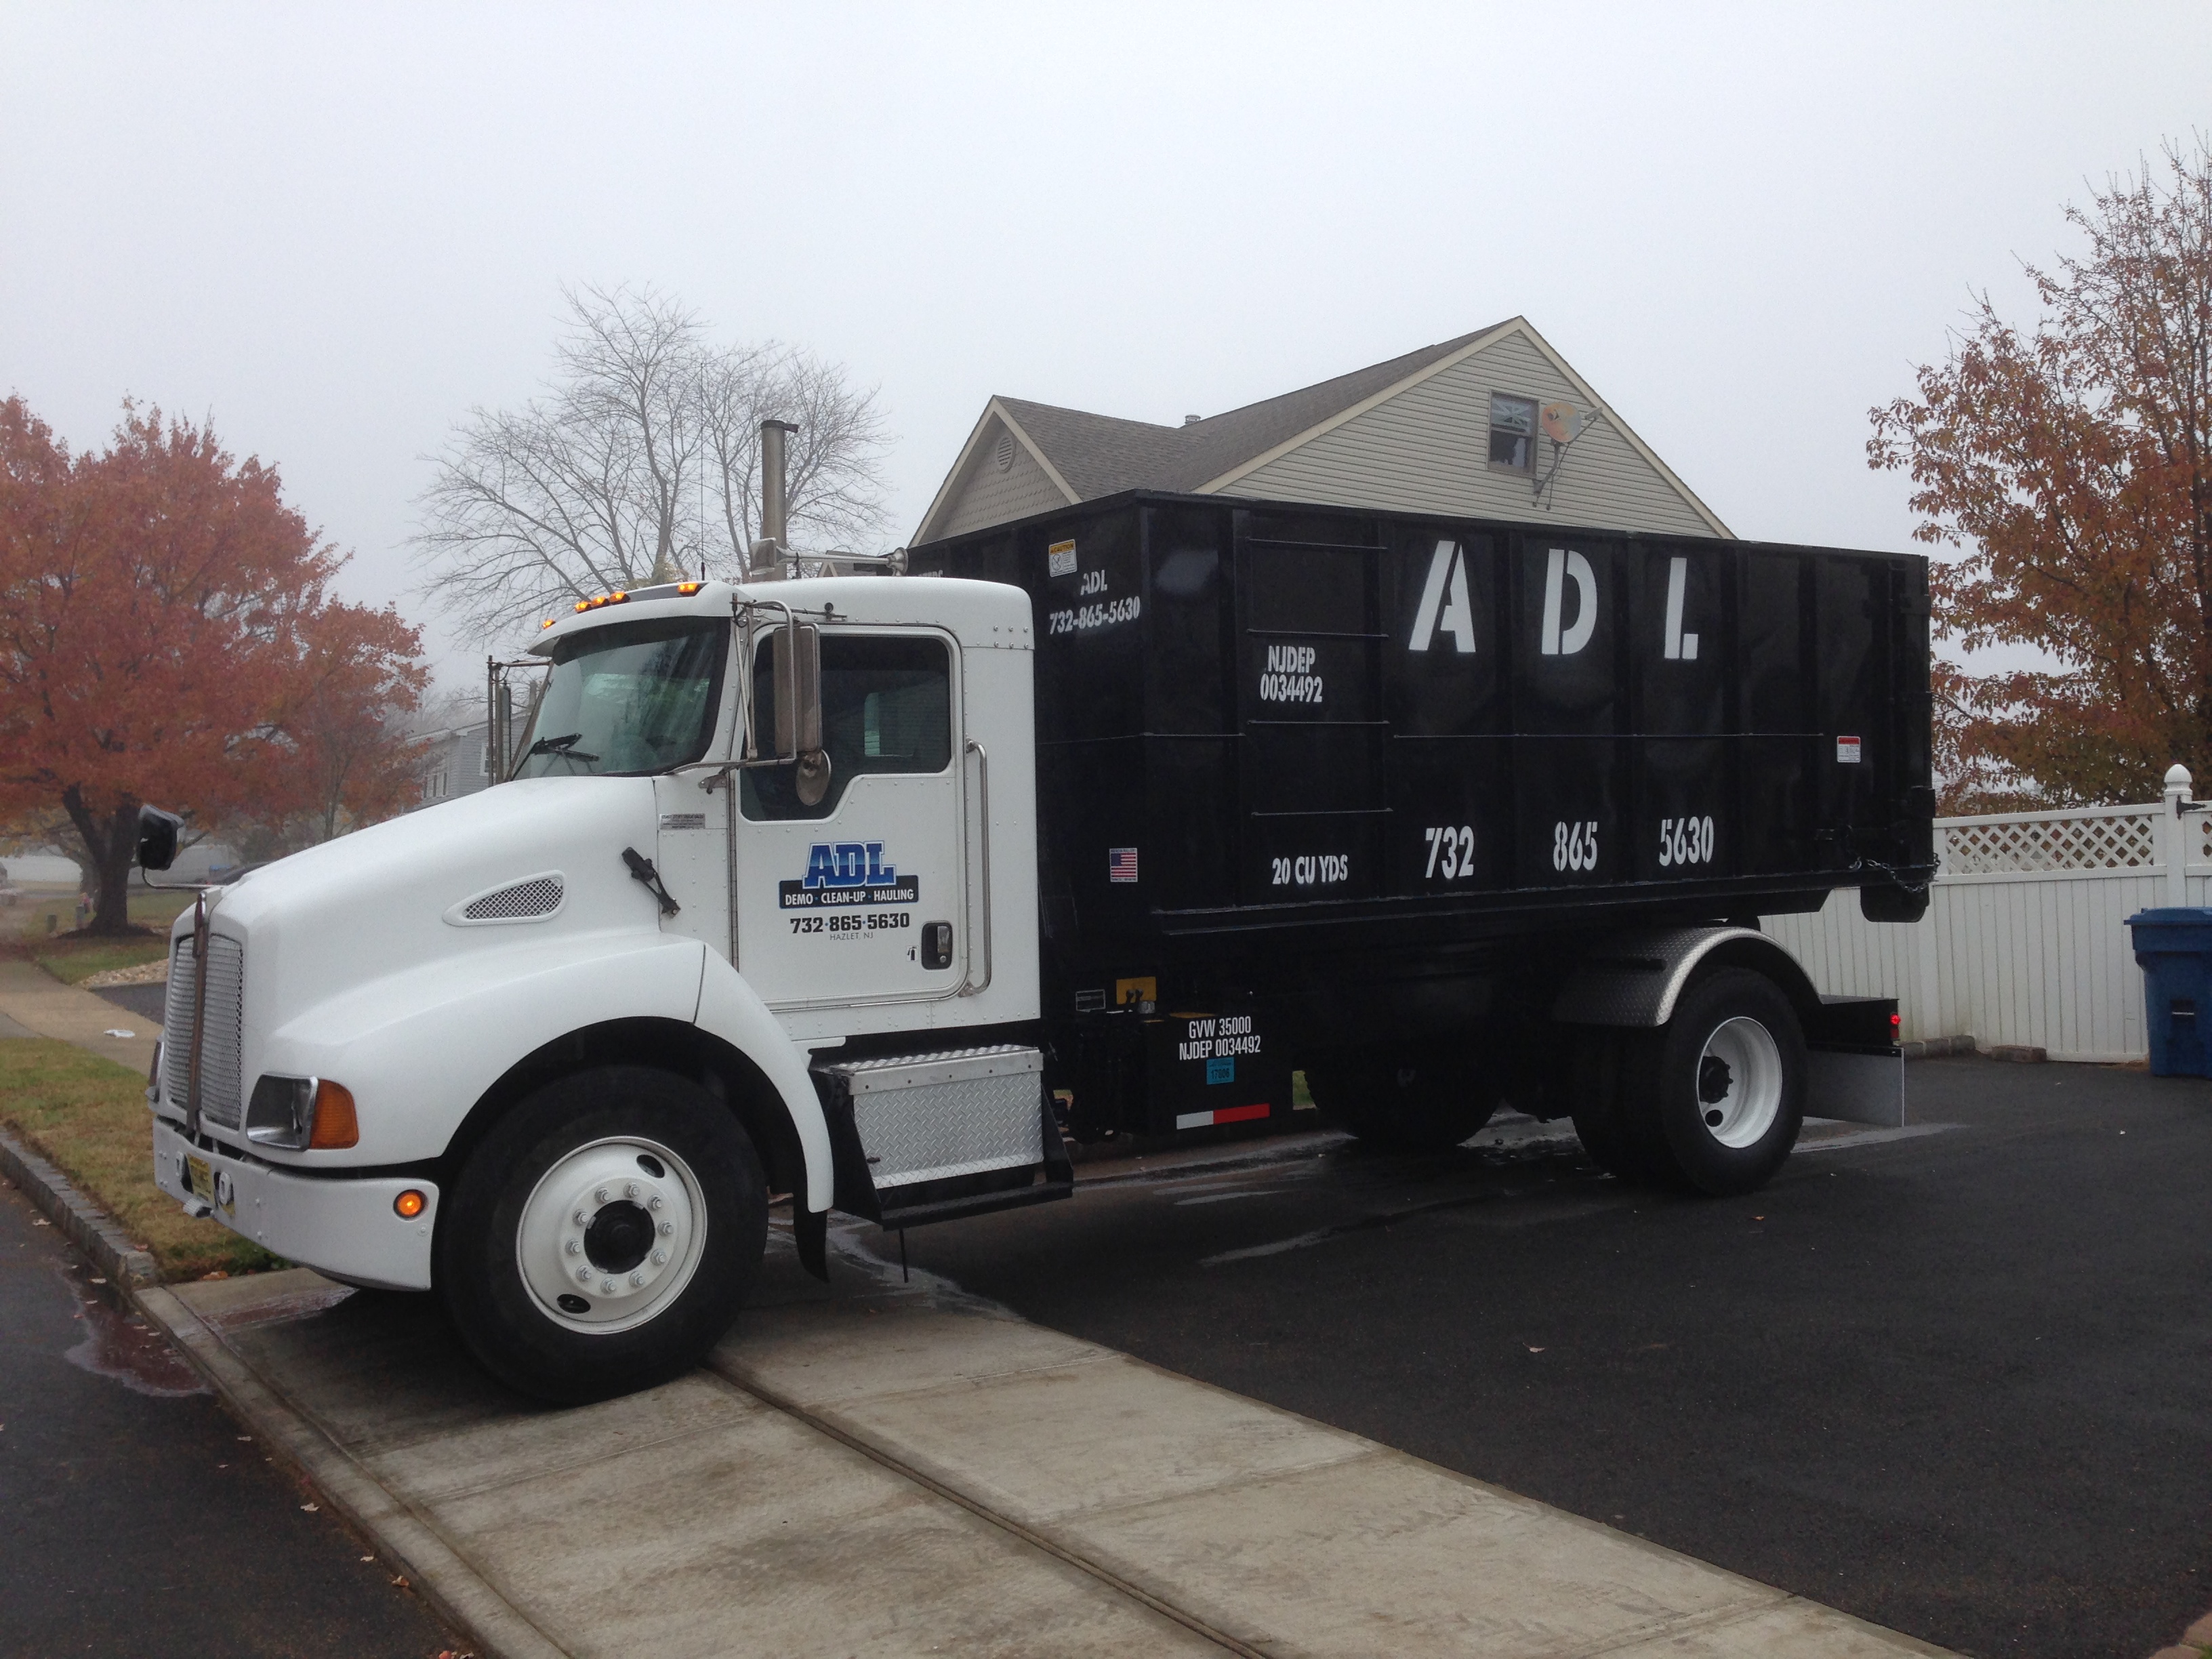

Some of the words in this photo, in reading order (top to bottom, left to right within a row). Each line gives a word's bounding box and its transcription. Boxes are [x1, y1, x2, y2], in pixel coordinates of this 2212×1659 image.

[1080, 570, 1108, 596] ADL
[1050, 596, 1141, 635] 732-865-5630
[1268, 645, 1315, 673] NJDEP
[1260, 673, 1323, 703] 0034492
[1426, 826, 1475, 879] 732
[1553, 821, 1598, 872] 865
[1659, 816, 1714, 867] 5630
[802, 840, 896, 889] ADL
[1272, 857, 1291, 884] 20
[1295, 856, 1315, 884] CU
[1318, 854, 1348, 882] YDS
[785, 893, 813, 905] DEMO
[821, 890, 866, 903] CLEAN-UP
[874, 888, 914, 901] HAULING
[863, 932, 874, 941] NJ
[1189, 1019, 1216, 1039] GVW
[1218, 1016, 1251, 1036] 35000
[1179, 1040, 1212, 1060] NJDEP
[1215, 1036, 1261, 1057] 0034492
